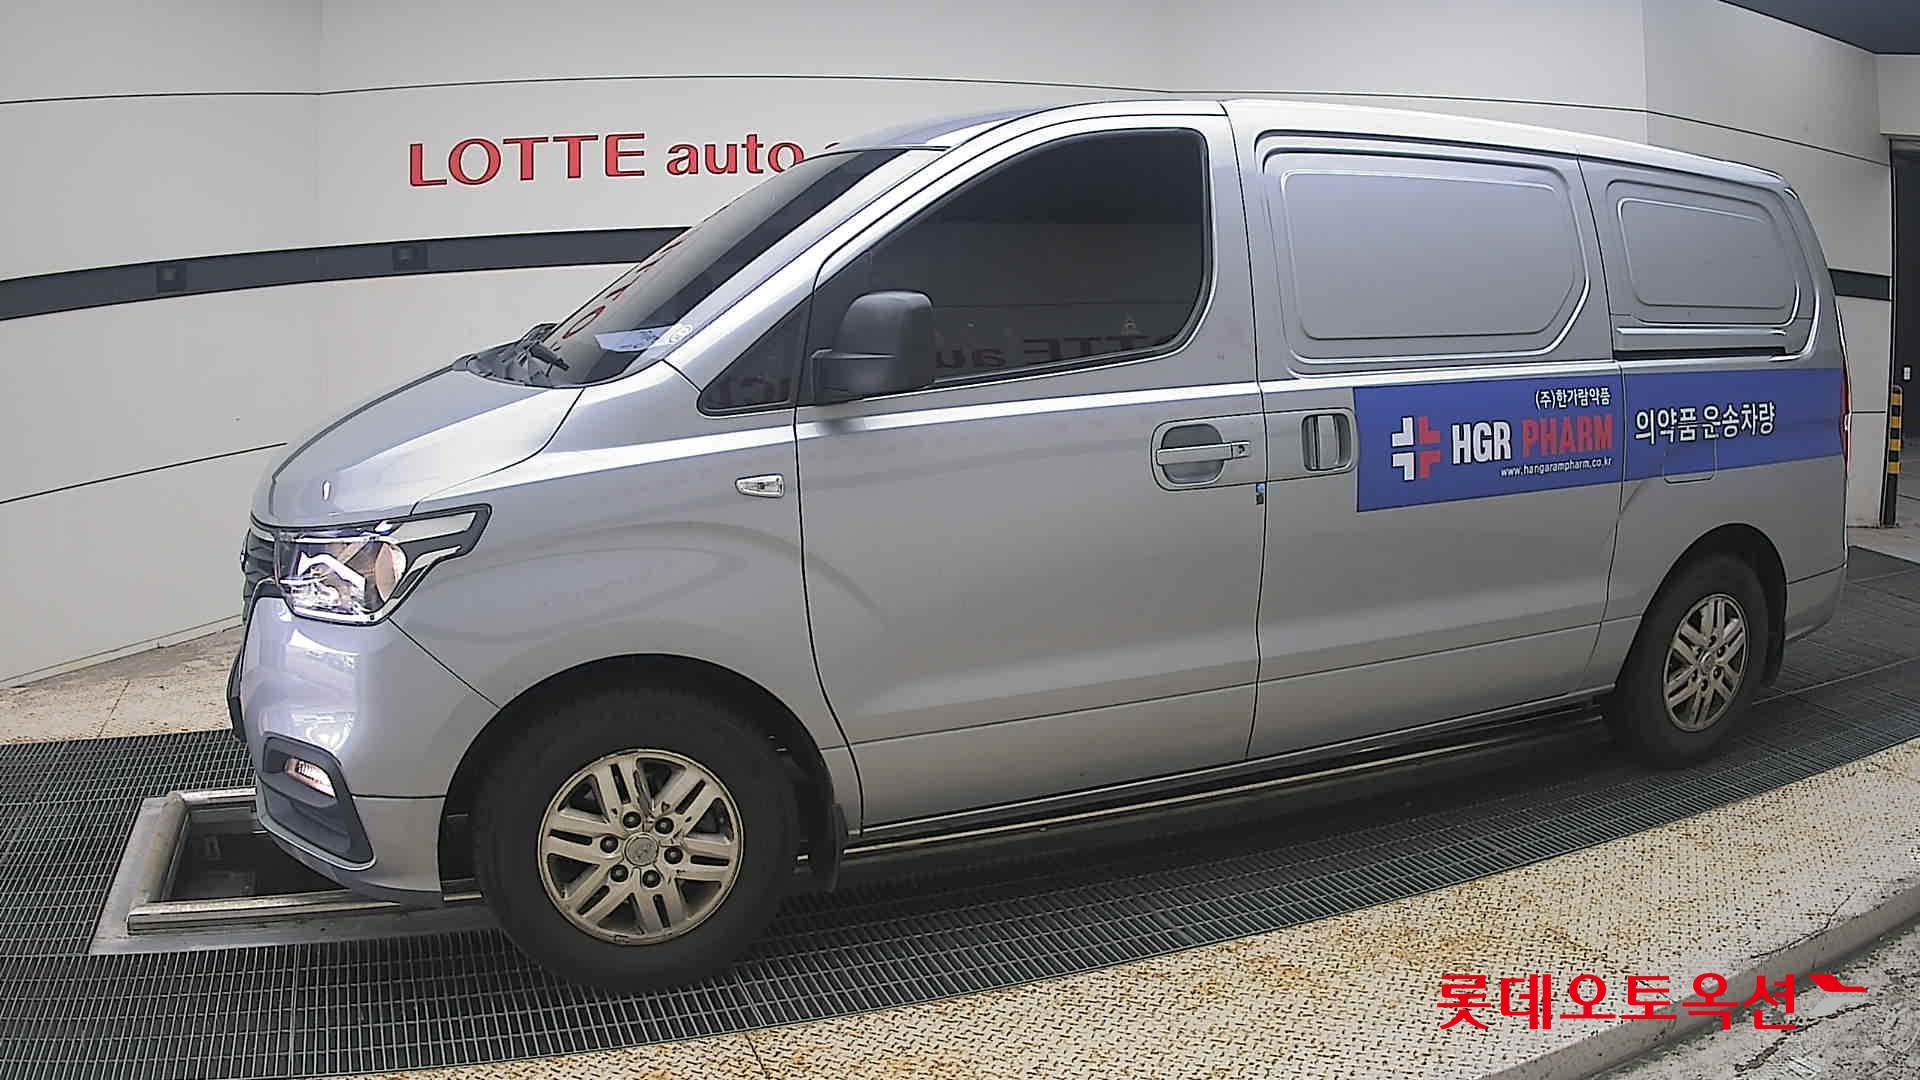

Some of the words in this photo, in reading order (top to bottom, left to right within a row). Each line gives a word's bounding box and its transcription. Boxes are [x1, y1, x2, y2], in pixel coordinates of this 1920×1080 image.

[408, 133, 645, 187] LOTTE
[666, 134, 804, 176] auto
[1535, 387, 1612, 408] (주)한가람약품
[1451, 421, 1512, 464] HGR
[1521, 414, 1614, 457] PHARM
[1635, 407, 1697, 444] 의약품
[1700, 401, 1775, 439] 운송차량
